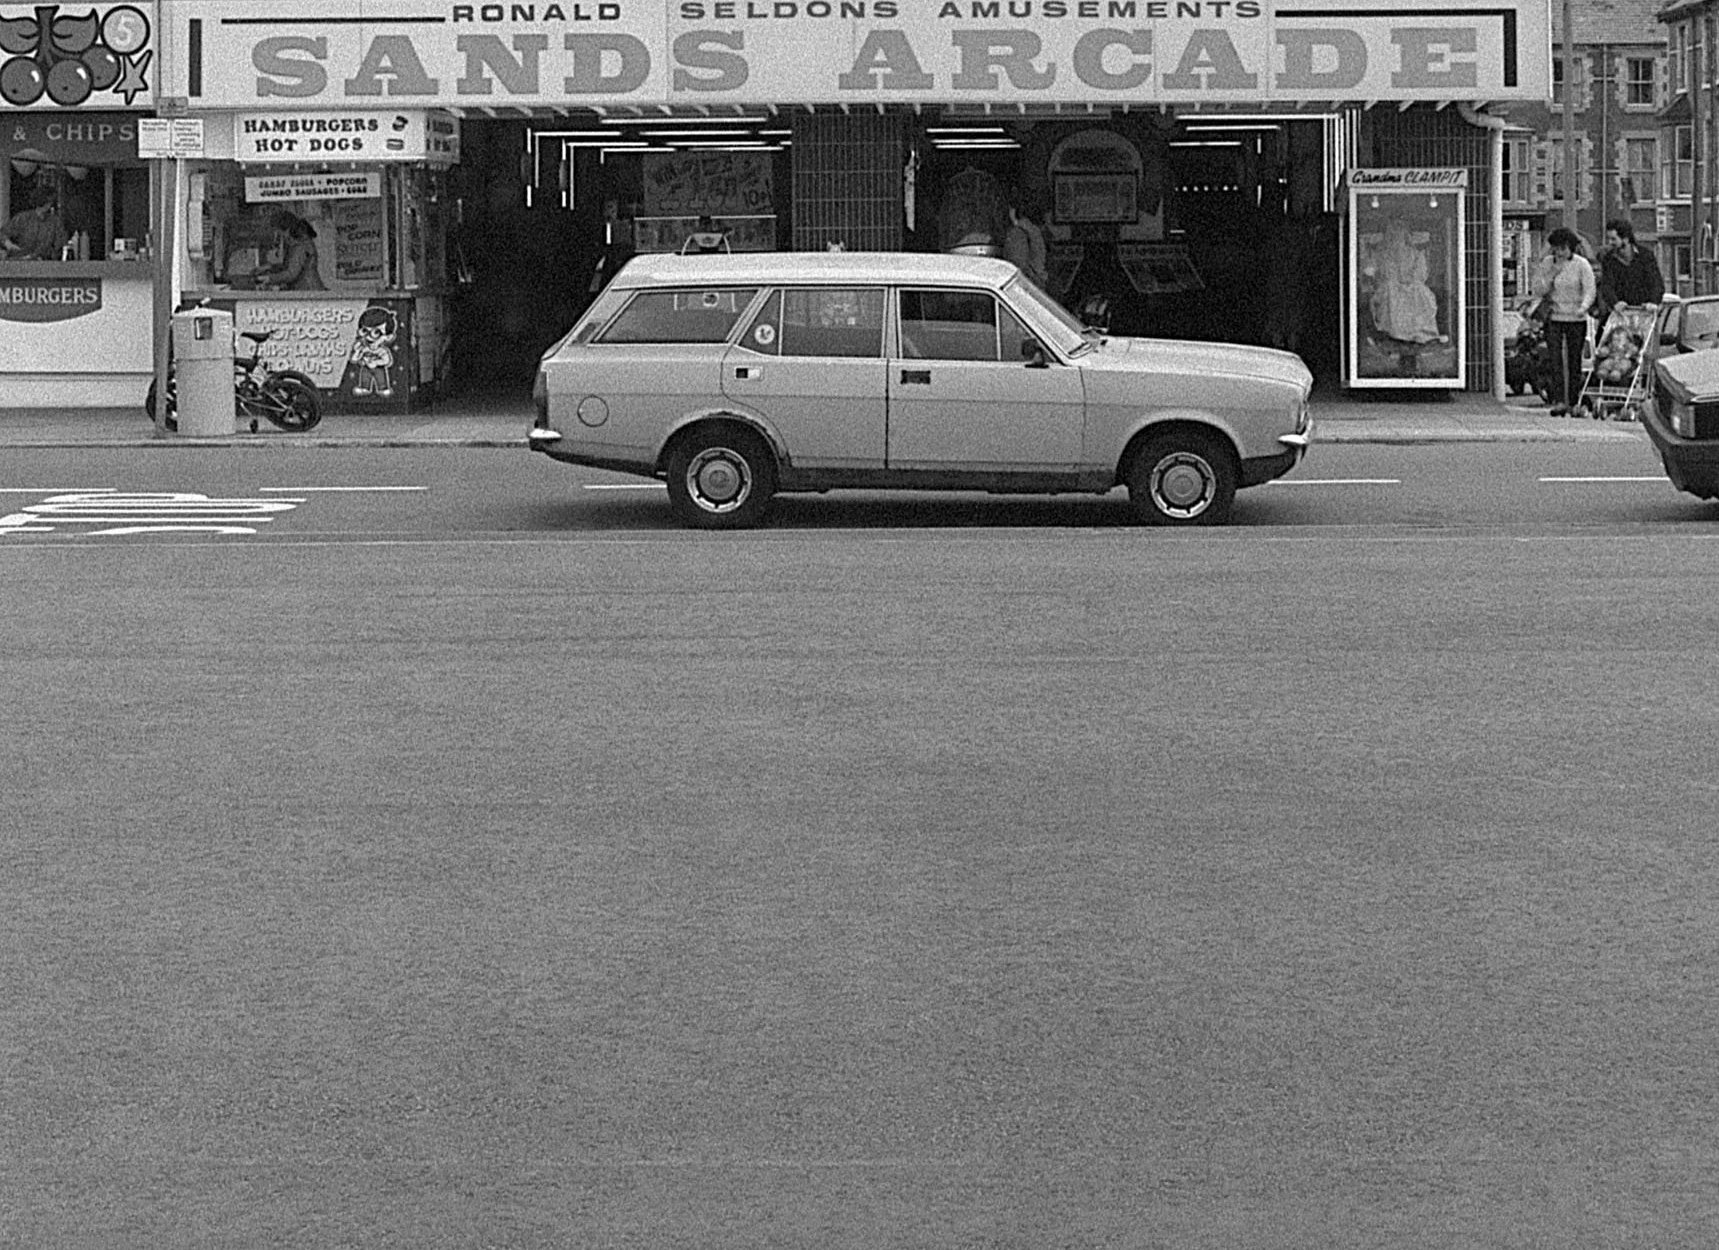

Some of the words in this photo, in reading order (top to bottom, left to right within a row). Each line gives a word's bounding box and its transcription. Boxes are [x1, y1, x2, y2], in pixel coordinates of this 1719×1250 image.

[452, 3, 622, 23] RONALD
[680, 1, 899, 19] SELDONS
[938, 0, 1262, 19] AMUSEMENTS
[114, 14, 135, 45] 5
[251, 28, 750, 98] SANDS
[838, 26, 1478, 91] ARCADE
[12, 125, 26, 141] &
[46, 123, 135, 141] CHIPS
[244, 118, 379, 133] HAMBURGERS
[255, 139, 298, 152] HOT
[309, 137, 363, 151] DOGS
[326, 177, 367, 186] POPCORN
[1404, 170, 1464, 184] CLAMPIT
[260, 188, 291, 197] JUMBO
